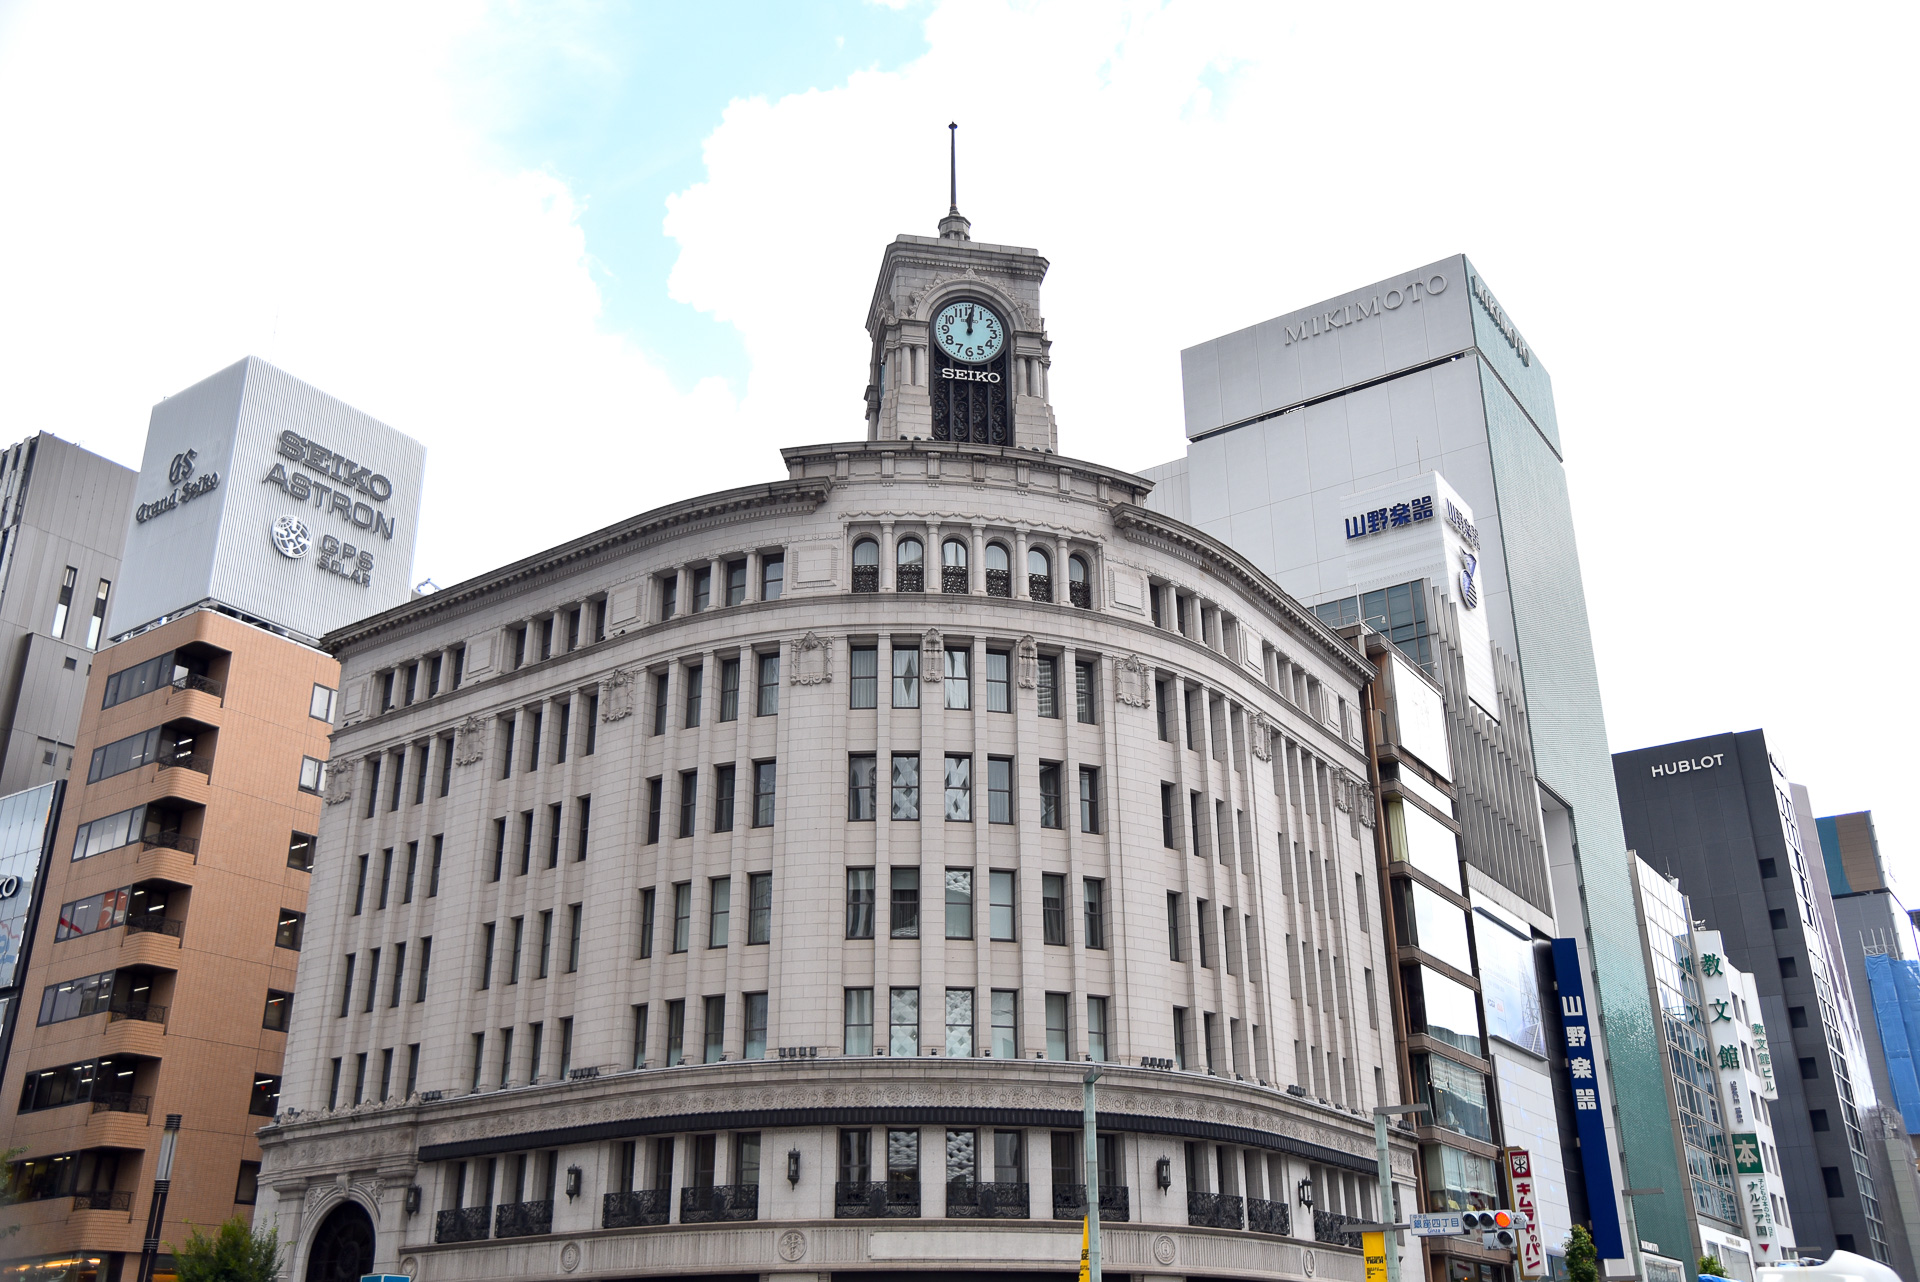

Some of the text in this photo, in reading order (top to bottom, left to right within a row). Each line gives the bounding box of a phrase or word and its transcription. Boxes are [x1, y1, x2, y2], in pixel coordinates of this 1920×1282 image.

[945, 315, 954, 325] 10
[954, 308, 962, 318] 11
[979, 310, 983, 321] 1
[1284, 274, 1448, 346] MIKIMOTO
[941, 324, 950, 334] 9
[985, 318, 994, 329] 2
[989, 329, 998, 340] 3
[945, 335, 954, 345] 8
[955, 343, 964, 353] 7
[965, 347, 974, 357] 6
[976, 345, 985, 355] 5
[985, 340, 994, 349] 4
[942, 367, 1000, 383] SEIKO
[277, 430, 392, 501] SEIKO
[136, 471, 221, 524] Grand Seiko
[262, 463, 395, 540] ASTRON
[1345, 495, 1434, 540] 山野楽器
[1446, 498, 1481, 551] 山野楽器
[320, 534, 374, 572] GPS
[317, 553, 371, 587] SOLAR
[1651, 753, 1724, 778] HUBLOT
[1702, 953, 1740, 1070] 教文館
[1562, 996, 1597, 1110] 山野楽器
[1751, 1023, 1775, 1092] 教文館ビル
[1730, 1080, 1740, 1105] SINCE
[1734, 1140, 1758, 1168] 本
[1747, 1181, 1768, 1237] ナルニア国
[1413, 1217, 1459, 1229] 銀座四丁目
